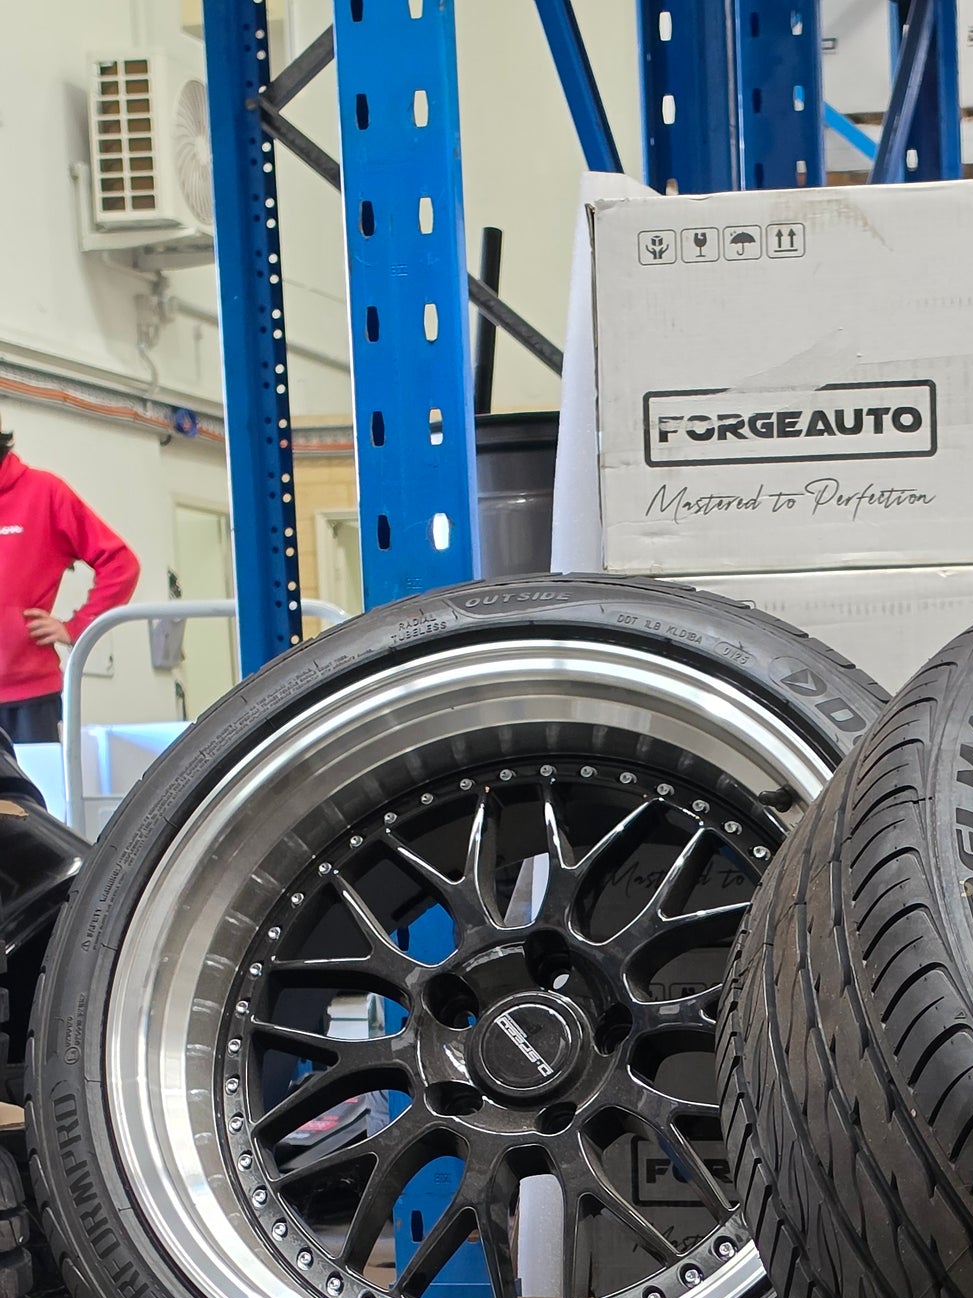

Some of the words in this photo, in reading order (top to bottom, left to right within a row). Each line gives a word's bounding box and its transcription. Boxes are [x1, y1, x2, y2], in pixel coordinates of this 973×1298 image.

[658, 406, 923, 443] FORGEAUTO
[645, 484, 763, 524] Mastered
[764, 491, 805, 513] to
[804, 478, 936, 522] Perfection
[465, 591, 571, 608] OUTSIDE
[399, 614, 437, 632] RADIAL
[617, 614, 638, 625] DOT
[390, 621, 448, 643] TUBELESS
[645, 1158, 734, 1184] FR
